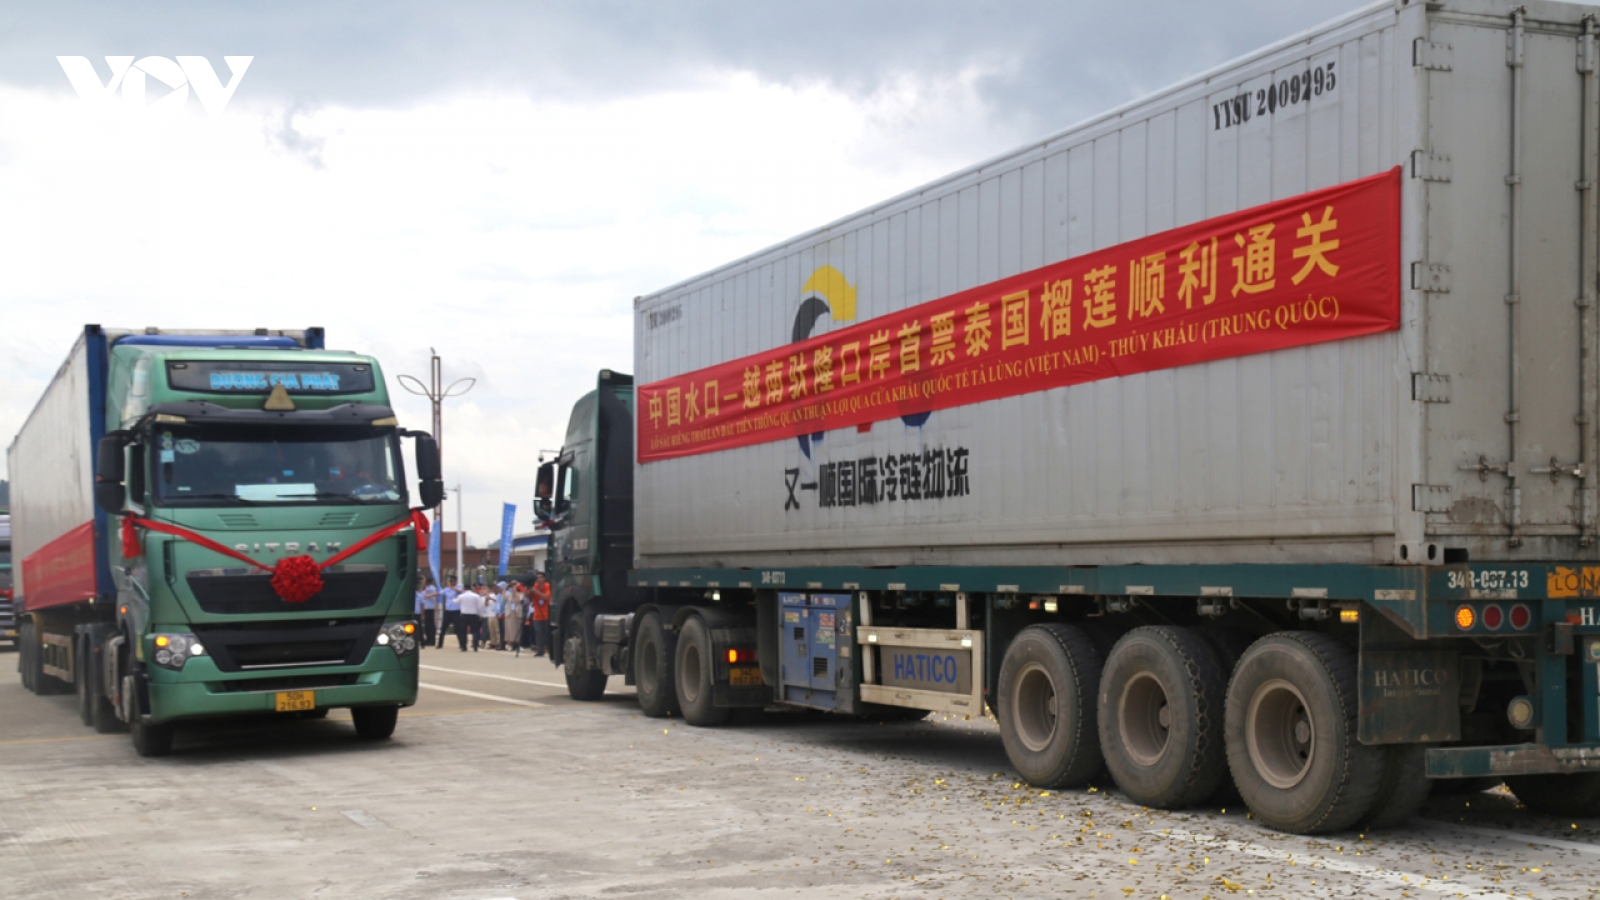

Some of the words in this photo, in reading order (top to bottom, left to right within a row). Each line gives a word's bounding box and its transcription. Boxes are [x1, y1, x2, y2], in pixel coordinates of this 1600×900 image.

[1213, 91, 1252, 130] YYSU
[1257, 61, 1336, 116] 2009295
[755, 411, 780, 431] THÔNG
[781, 408, 802, 428] QUAN
[850, 395, 870, 413] QUA
[971, 363, 986, 386] TÀ
[989, 360, 1022, 383] LÙNG
[1024, 351, 1060, 378] (VIỆT
[1062, 344, 1100, 368] NAM)
[1108, 330, 1149, 358] THỦY
[1202, 309, 1271, 344] (TRUNG
[1275, 293, 1340, 330] QUỐC)
[784, 446, 970, 511] 又一顺国际冷链物流
[234, 541, 342, 554] SITRAK
[1555, 573, 1600, 591] LON
[1580, 606, 1600, 626] H
[893, 653, 957, 684] HATICO
[1374, 669, 1447, 687] HATICO
